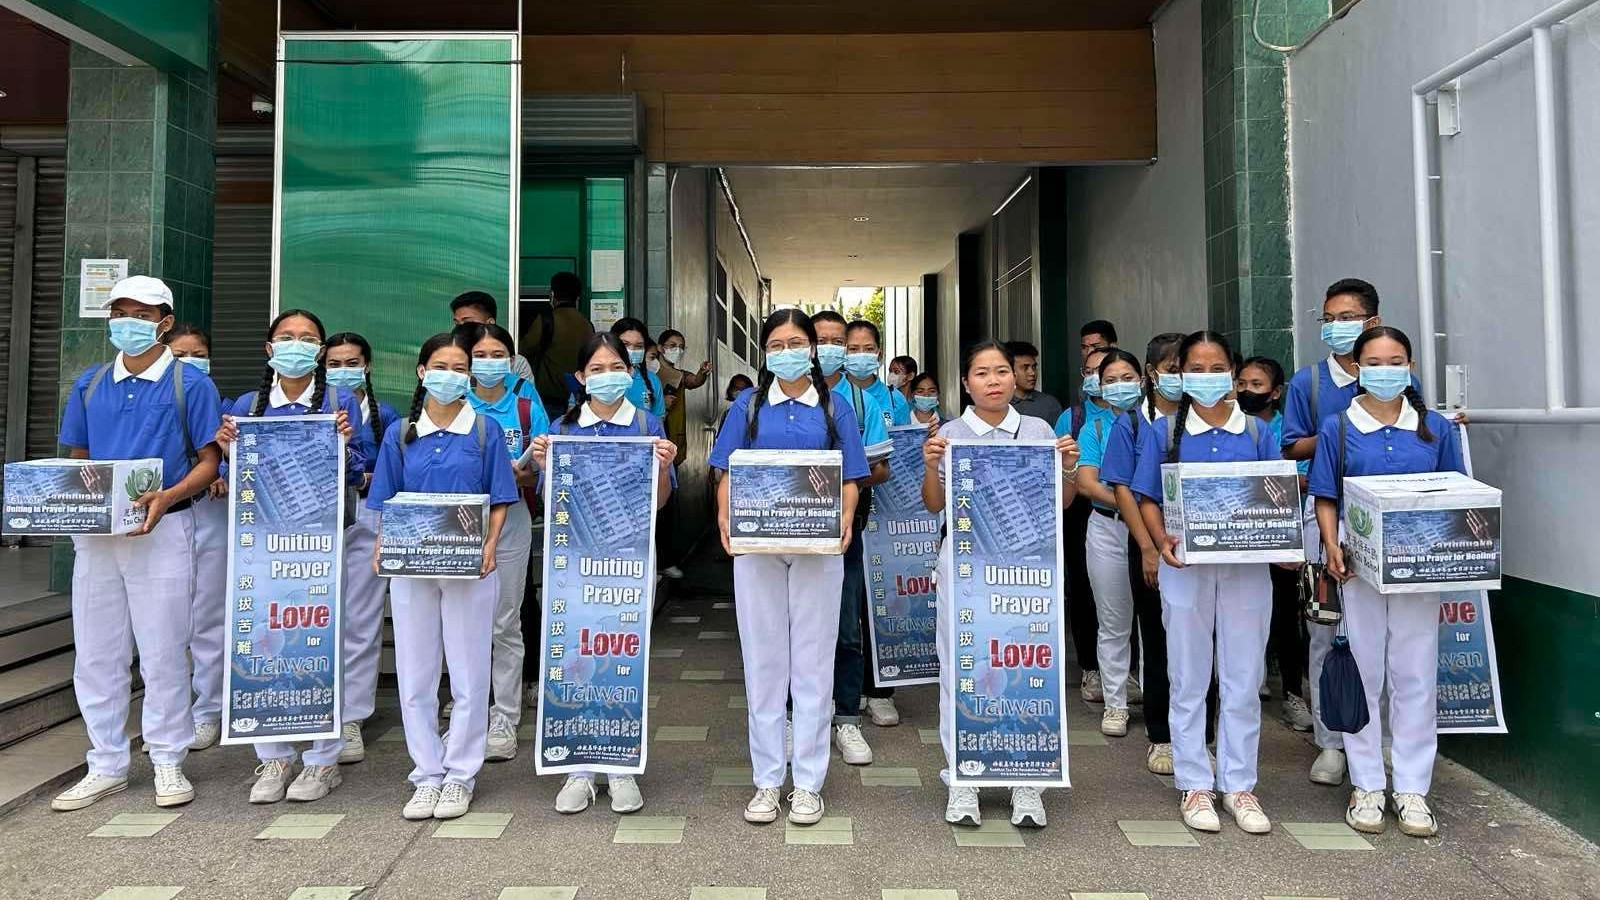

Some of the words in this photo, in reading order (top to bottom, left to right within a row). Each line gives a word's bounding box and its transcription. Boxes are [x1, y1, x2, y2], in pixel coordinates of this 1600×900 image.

[42, 506, 66, 514] Prayer
[79, 505, 108, 514] Healing
[734, 509, 760, 518] Uniting
[770, 509, 794, 518] Prayer
[808, 508, 837, 518] Healing
[887, 518, 938, 535] Uniting
[1189, 522, 1218, 530] Uniting
[1228, 522, 1253, 530] Prayer
[1268, 520, 1297, 529] Healing
[267, 533, 332, 552] Uniting
[416, 547, 441, 555] Prayer
[1388, 556, 1417, 564] Uniting
[1426, 553, 1452, 562] Prayer
[1454, 552, 1464, 561] for
[1466, 552, 1496, 561] Healing
[271, 560, 331, 579] Prayer
[580, 558, 644, 577] Uniting
[985, 566, 1051, 587] Uniting
[310, 584, 328, 594] and
[584, 584, 642, 605] Prayer
[928, 600, 936, 608] fo
[990, 594, 1050, 614] Prayer
[1439, 601, 1476, 624] ve
[268, 601, 330, 630] Love
[620, 612, 638, 622] and
[887, 616, 936, 632] Taiwa
[1030, 622, 1048, 632] and
[307, 636, 321, 646] for
[580, 628, 640, 657] Love
[1456, 632, 1470, 642] for
[879, 642, 936, 659] Earthqua
[990, 638, 1052, 669] Love
[249, 655, 329, 675] Taiwan
[617, 664, 630, 675] for
[1030, 677, 1044, 688] for
[232, 687, 333, 710] Earthquake
[560, 682, 638, 703] Taiwan
[971, 695, 1054, 716] Taiwan
[544, 716, 640, 738] Earthquake
[958, 730, 1058, 752] Earthquake
